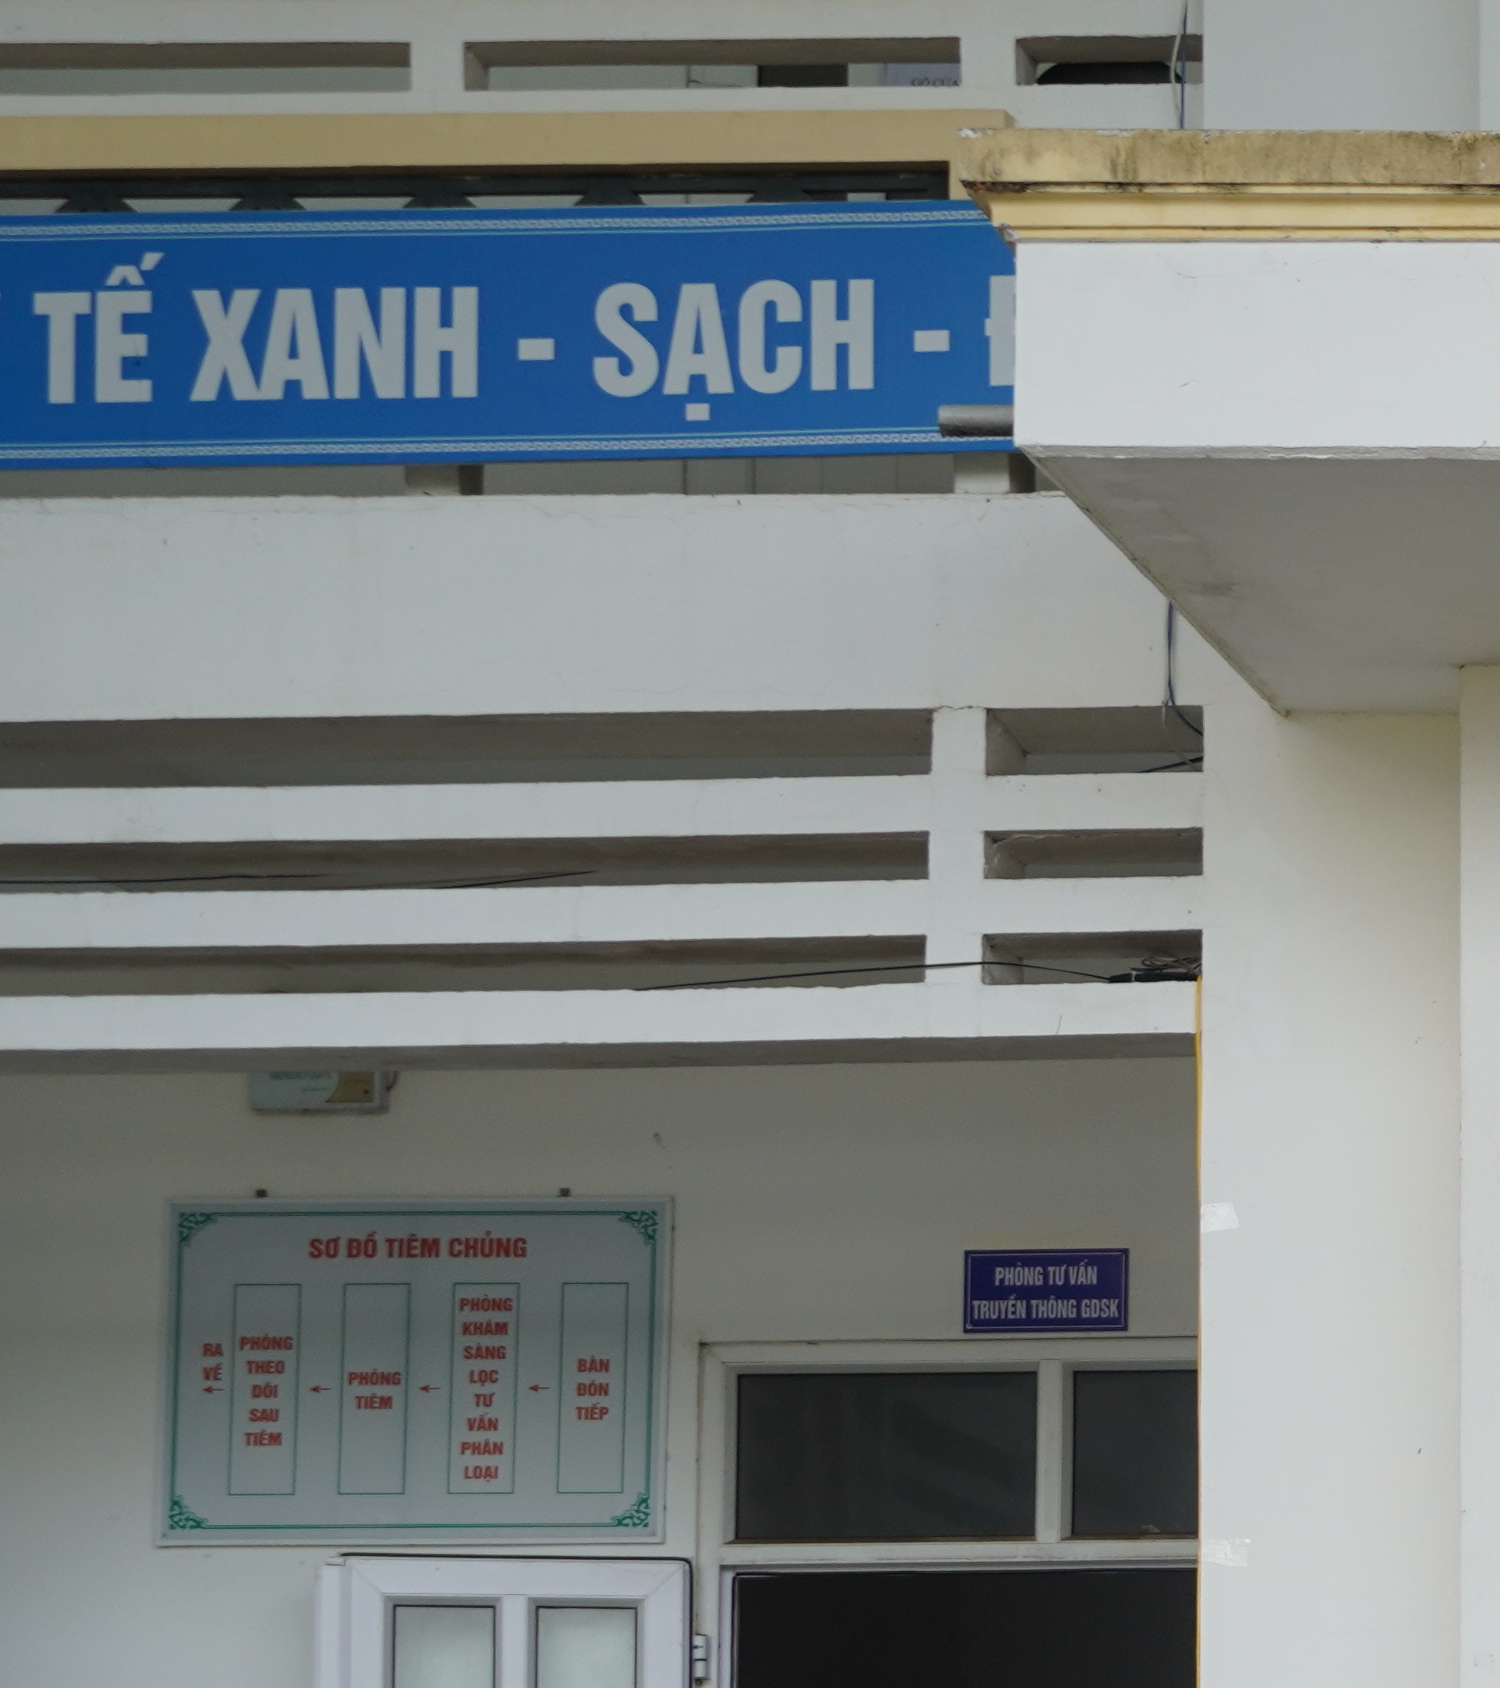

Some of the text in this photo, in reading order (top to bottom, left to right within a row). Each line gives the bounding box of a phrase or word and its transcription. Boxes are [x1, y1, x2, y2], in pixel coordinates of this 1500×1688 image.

[33, 252, 163, 404] TẾ
[190, 286, 478, 401] XANH
[518, 338, 554, 360] -
[593, 279, 874, 421] SẠCH
[914, 330, 949, 352] -
[307, 1230, 528, 1259] SƠ ĐỒ TIÊM CHỦNG
[994, 1259, 1098, 1286] PHÒNG TƯ VẤN
[459, 1296, 513, 1312] PHÒNG
[972, 1294, 1120, 1319] TRUYỀN THÔNG GDSK
[462, 1319, 509, 1336] KHÁM
[202, 1342, 224, 1358] RA
[239, 1335, 294, 1352] PHÒNG
[463, 1343, 507, 1361] SÀNG
[246, 1360, 286, 1375] THEO
[577, 1356, 611, 1373] BÀN
[348, 1369, 402, 1386] PHÒNG
[469, 1368, 500, 1387] LỌC
[577, 1380, 610, 1397] ĐÓN
[355, 1393, 394, 1410] TIÊM
[474, 1391, 496, 1407] TƯ
[249, 1408, 280, 1423] SAU
[575, 1403, 610, 1421] TIẾP
[467, 1412, 499, 1432] VẤN
[245, 1430, 283, 1447] TIÊM
[460, 1438, 504, 1456] PHÂN
[464, 1465, 500, 1483] LOẠI
